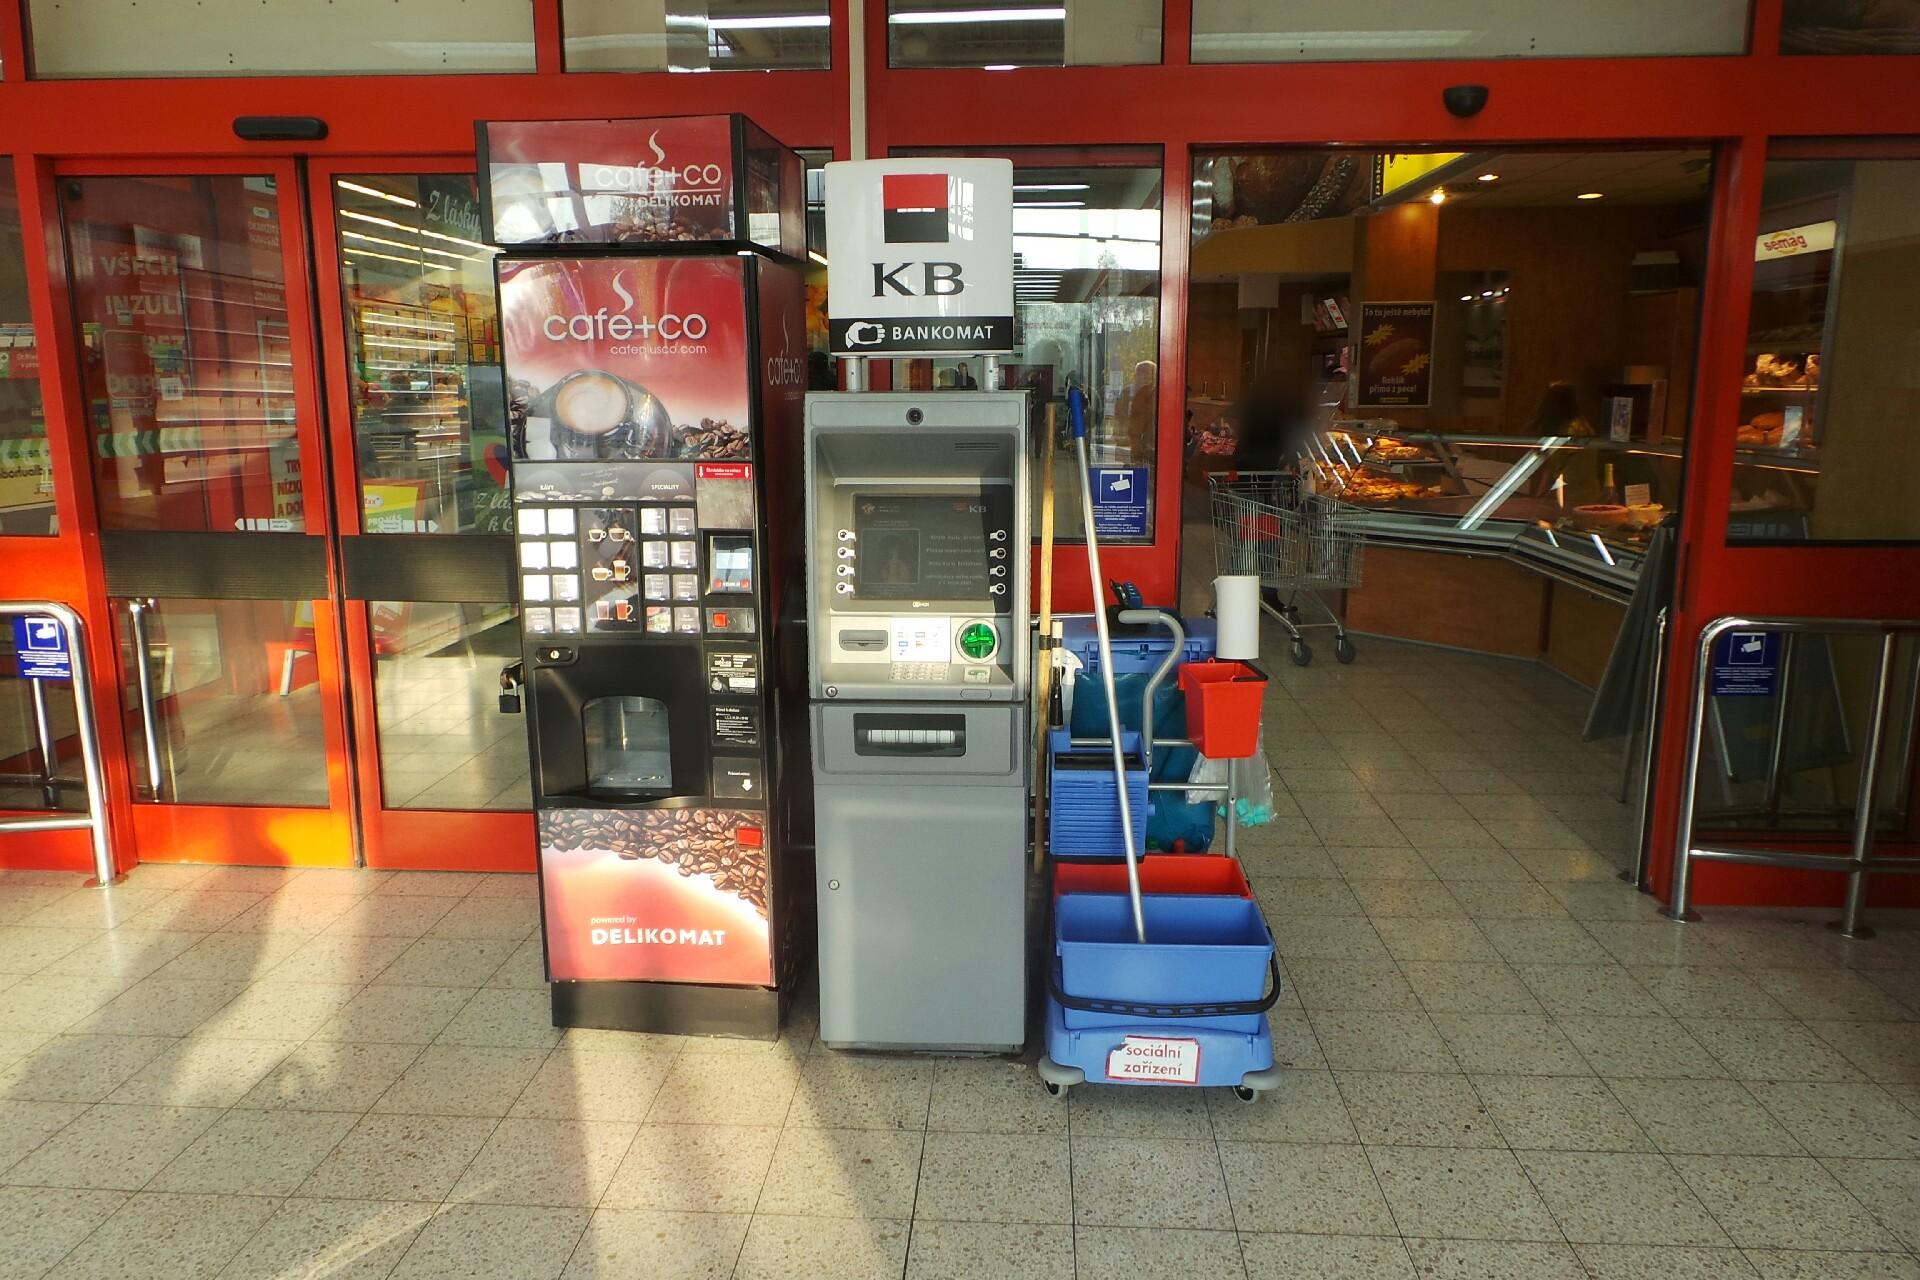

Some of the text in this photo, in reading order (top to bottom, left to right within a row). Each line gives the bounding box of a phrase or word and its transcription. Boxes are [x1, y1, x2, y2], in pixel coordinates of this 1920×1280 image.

[638, 194, 722, 207] DELIKOMAT
[1763, 235, 1808, 252] semag
[871, 261, 965, 297] KB
[892, 325, 994, 341] BANKOMAT
[969, 504, 987, 513] KB
[591, 916, 637, 926] powered by
[591, 928, 726, 946] DELIKOMAT
[1126, 1043, 1183, 1060] sociální
[1123, 1060, 1183, 1076] zařízení
